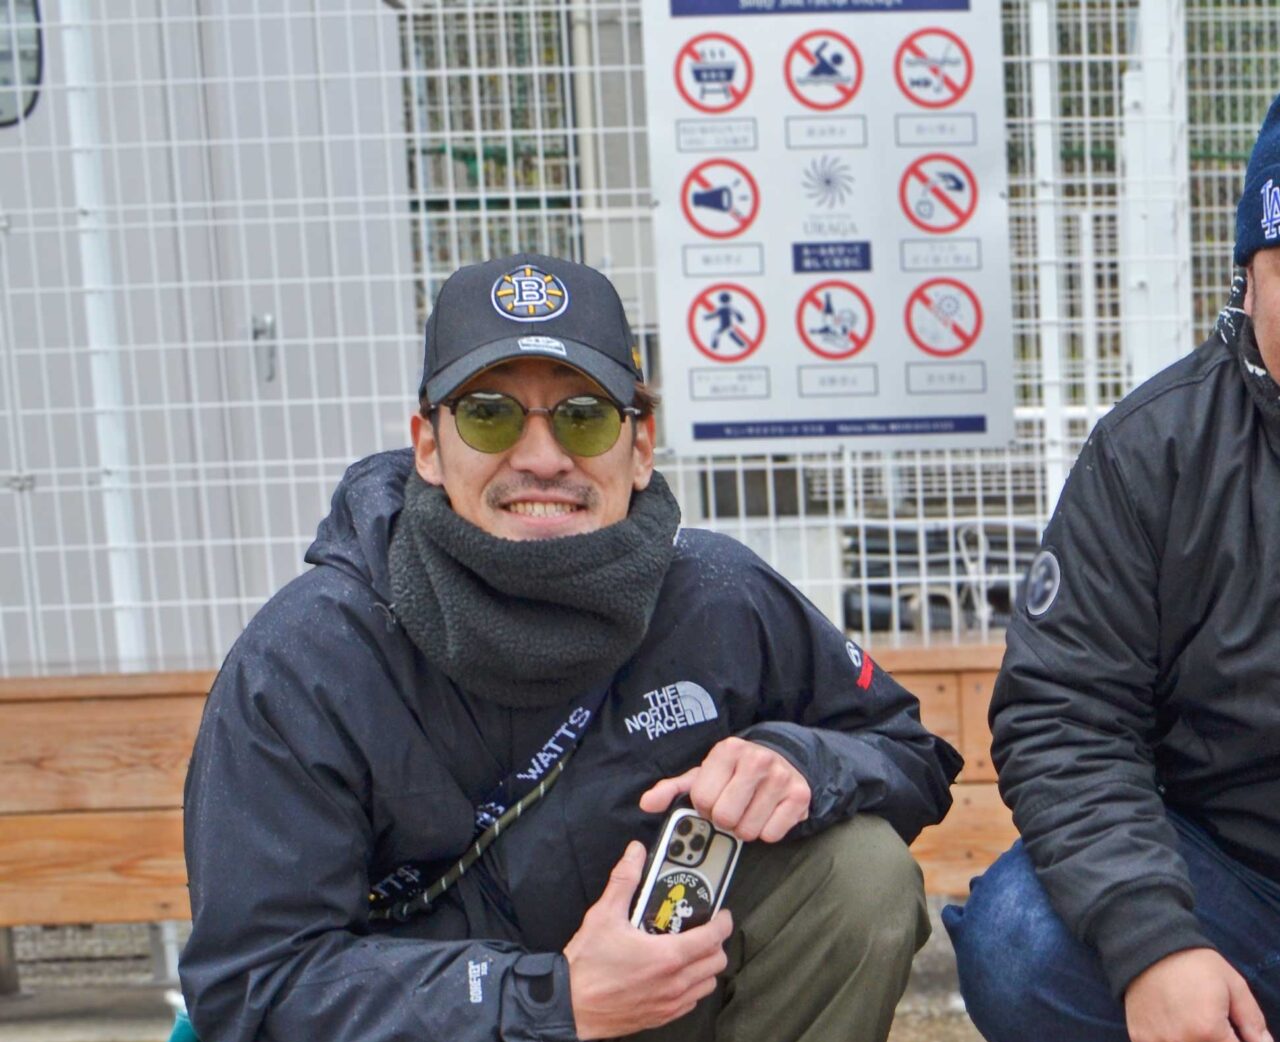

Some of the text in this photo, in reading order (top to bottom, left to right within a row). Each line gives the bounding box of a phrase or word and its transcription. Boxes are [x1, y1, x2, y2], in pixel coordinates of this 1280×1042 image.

[512, 276, 547, 306] B
[643, 684, 680, 709] THE
[624, 698, 685, 734] NORTH
[646, 715, 687, 741] FACE
[516, 706, 592, 780] WATTS
